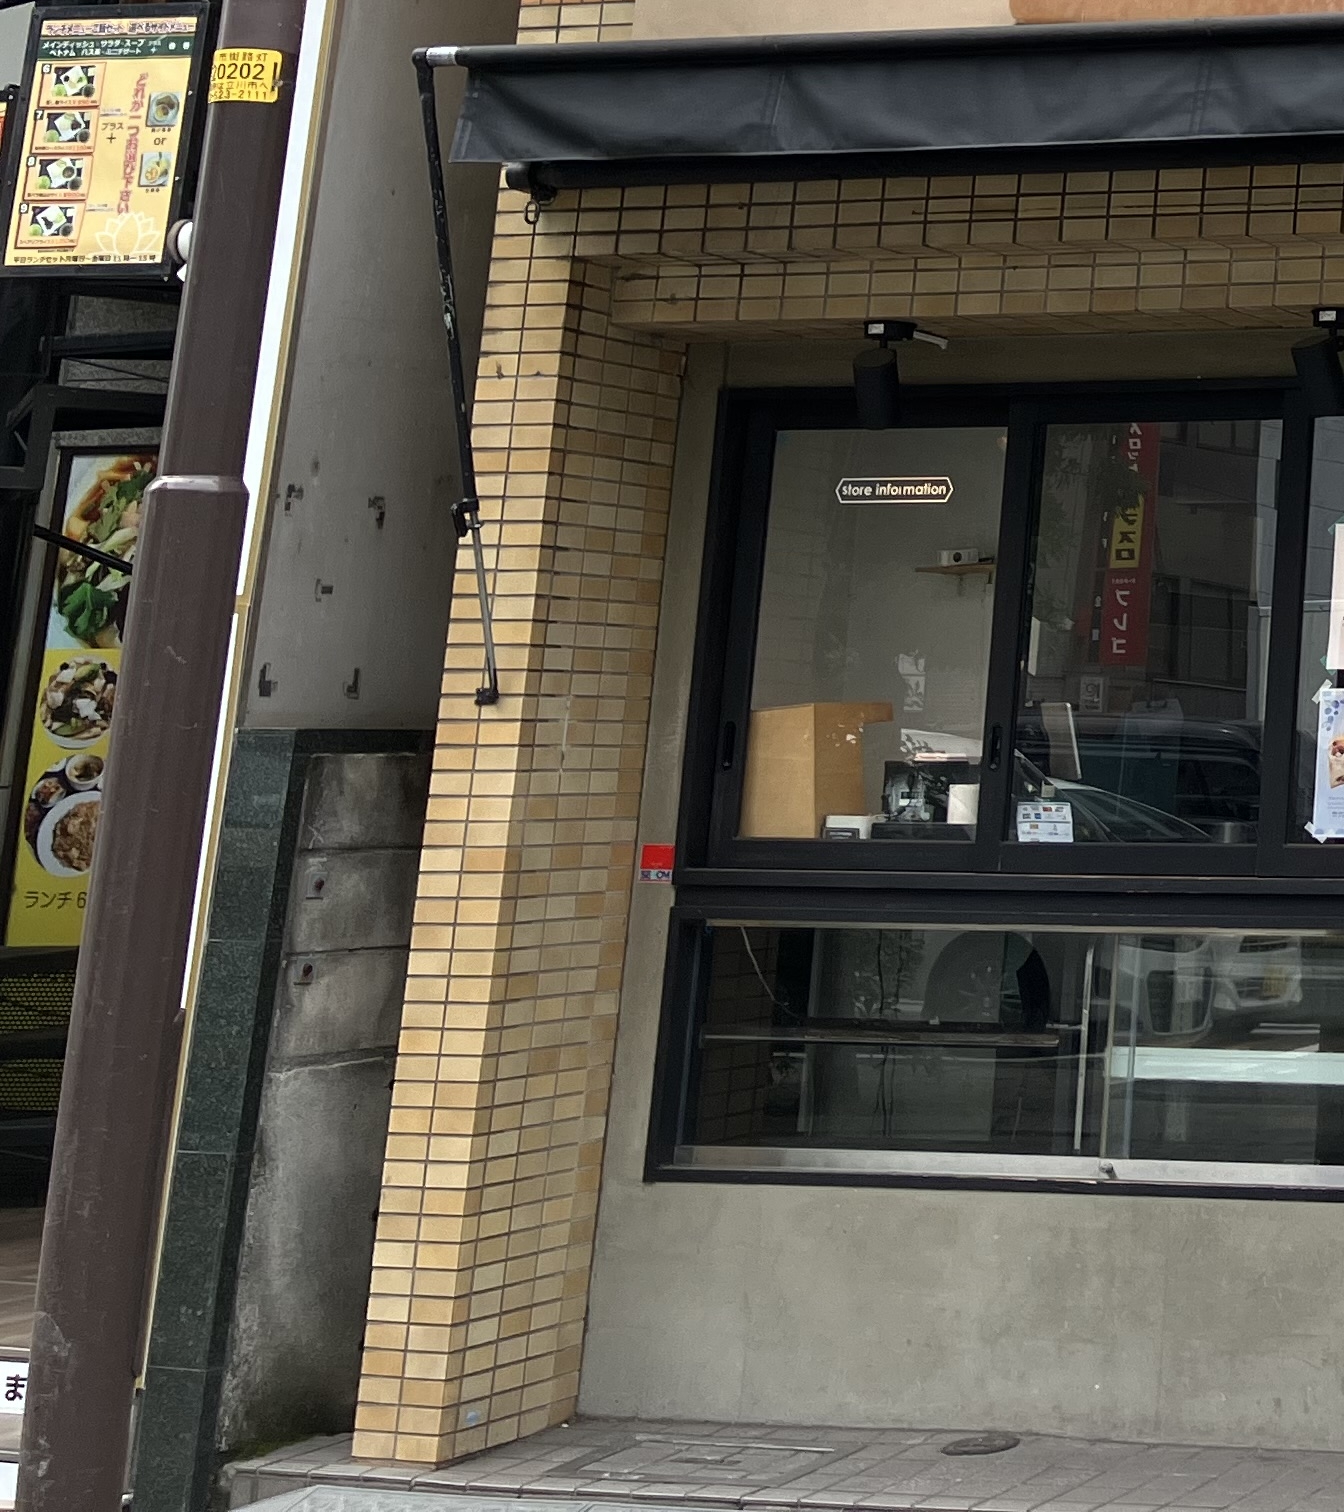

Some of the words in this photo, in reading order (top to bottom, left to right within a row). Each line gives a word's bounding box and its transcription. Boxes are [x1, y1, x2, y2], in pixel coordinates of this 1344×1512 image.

[153, 137, 168, 146] or
[841, 483, 872, 496] store
[875, 482, 947, 496] information
[23, 890, 72, 910] ランチ
